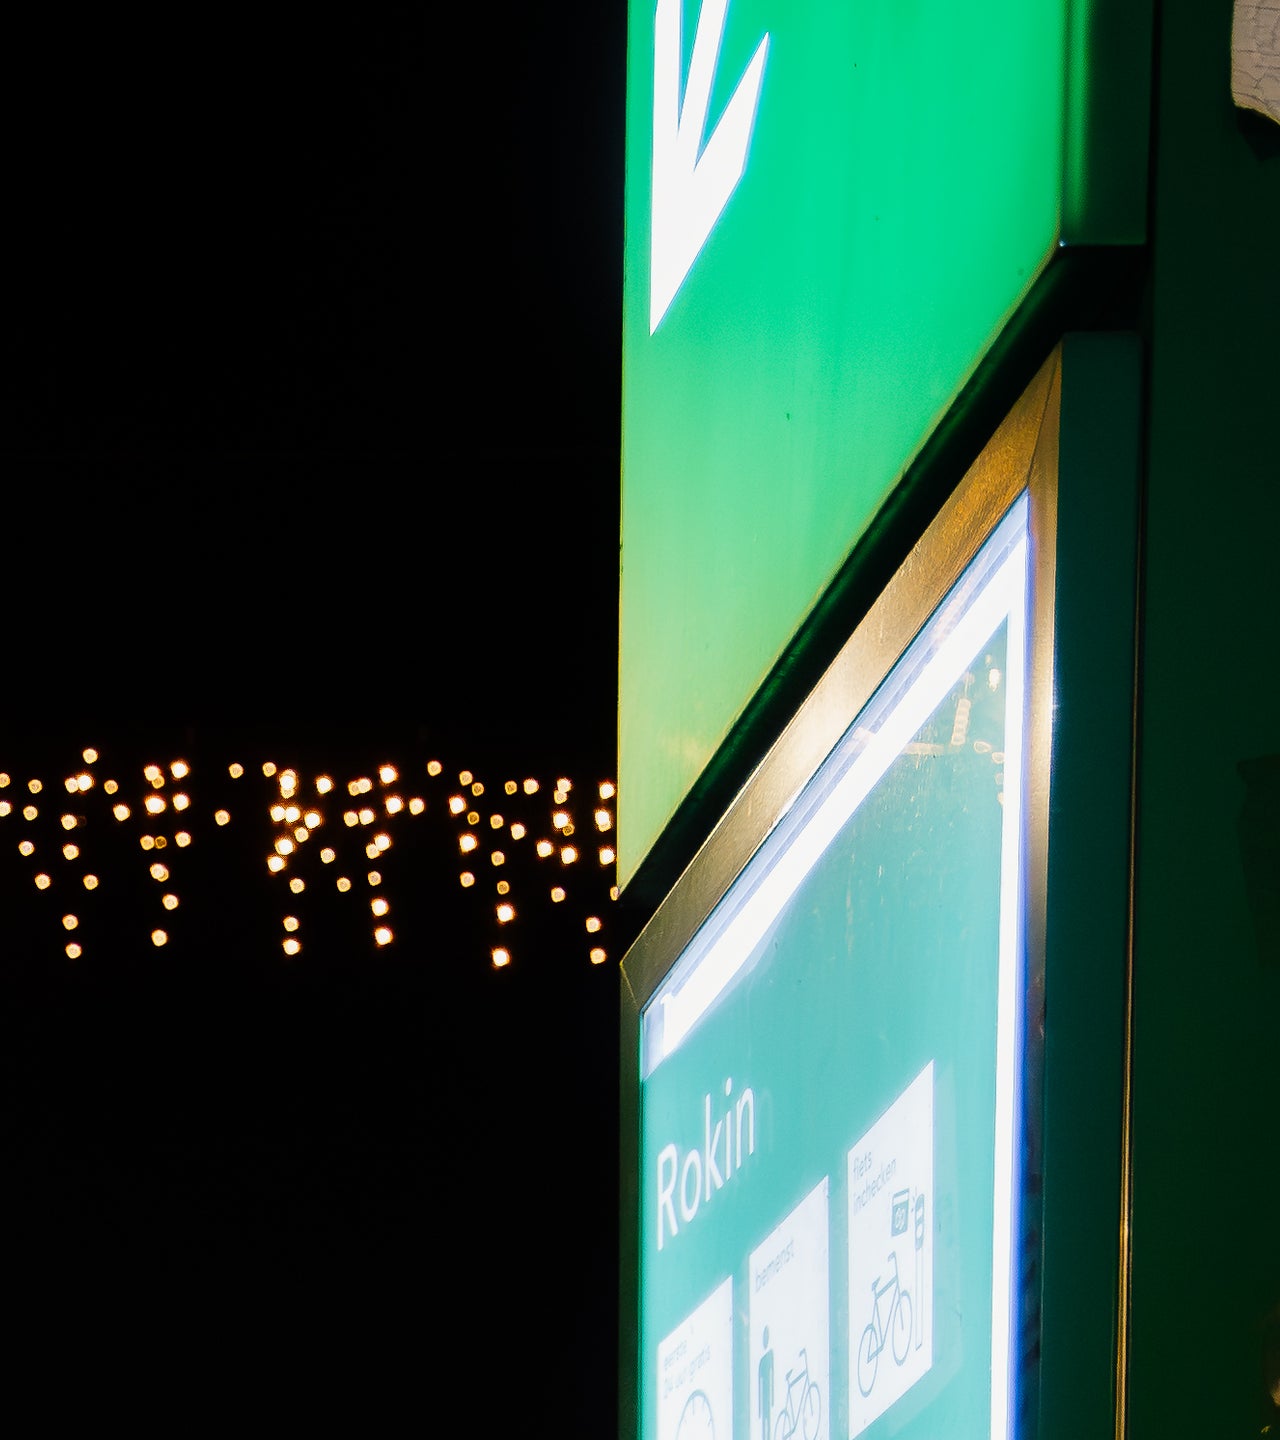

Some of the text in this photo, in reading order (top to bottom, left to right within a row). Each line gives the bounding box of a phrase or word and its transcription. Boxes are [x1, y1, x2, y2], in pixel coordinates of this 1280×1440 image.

[656, 1075, 754, 1253] Rokin
[853, 1152, 872, 1182] fiets
[854, 1158, 897, 1216] inchecken
